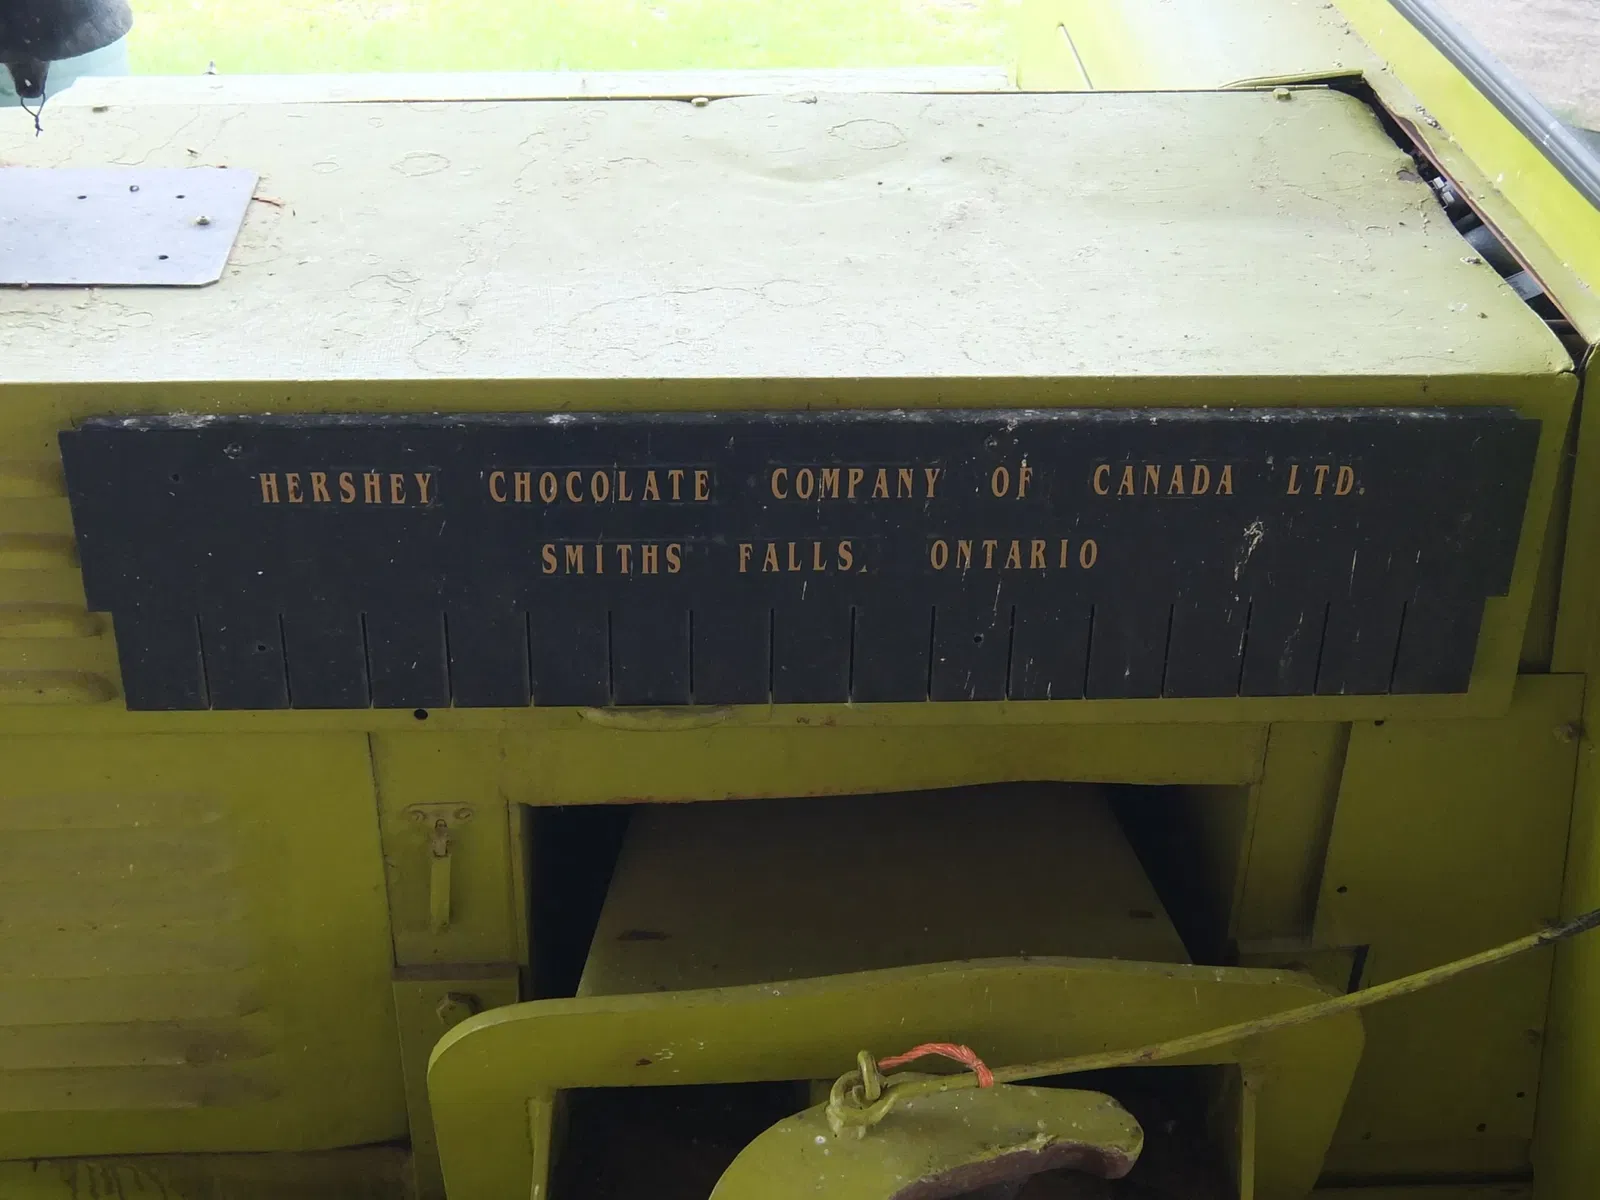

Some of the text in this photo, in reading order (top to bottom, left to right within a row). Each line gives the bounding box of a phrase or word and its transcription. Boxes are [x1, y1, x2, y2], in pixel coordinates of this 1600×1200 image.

[260, 464, 1366, 504] HERSHEY CHOCOLATE COMPANY OF CANADA LTD.
[541, 543, 682, 575] SMITHS
[930, 540, 1098, 570] ONTARIO
